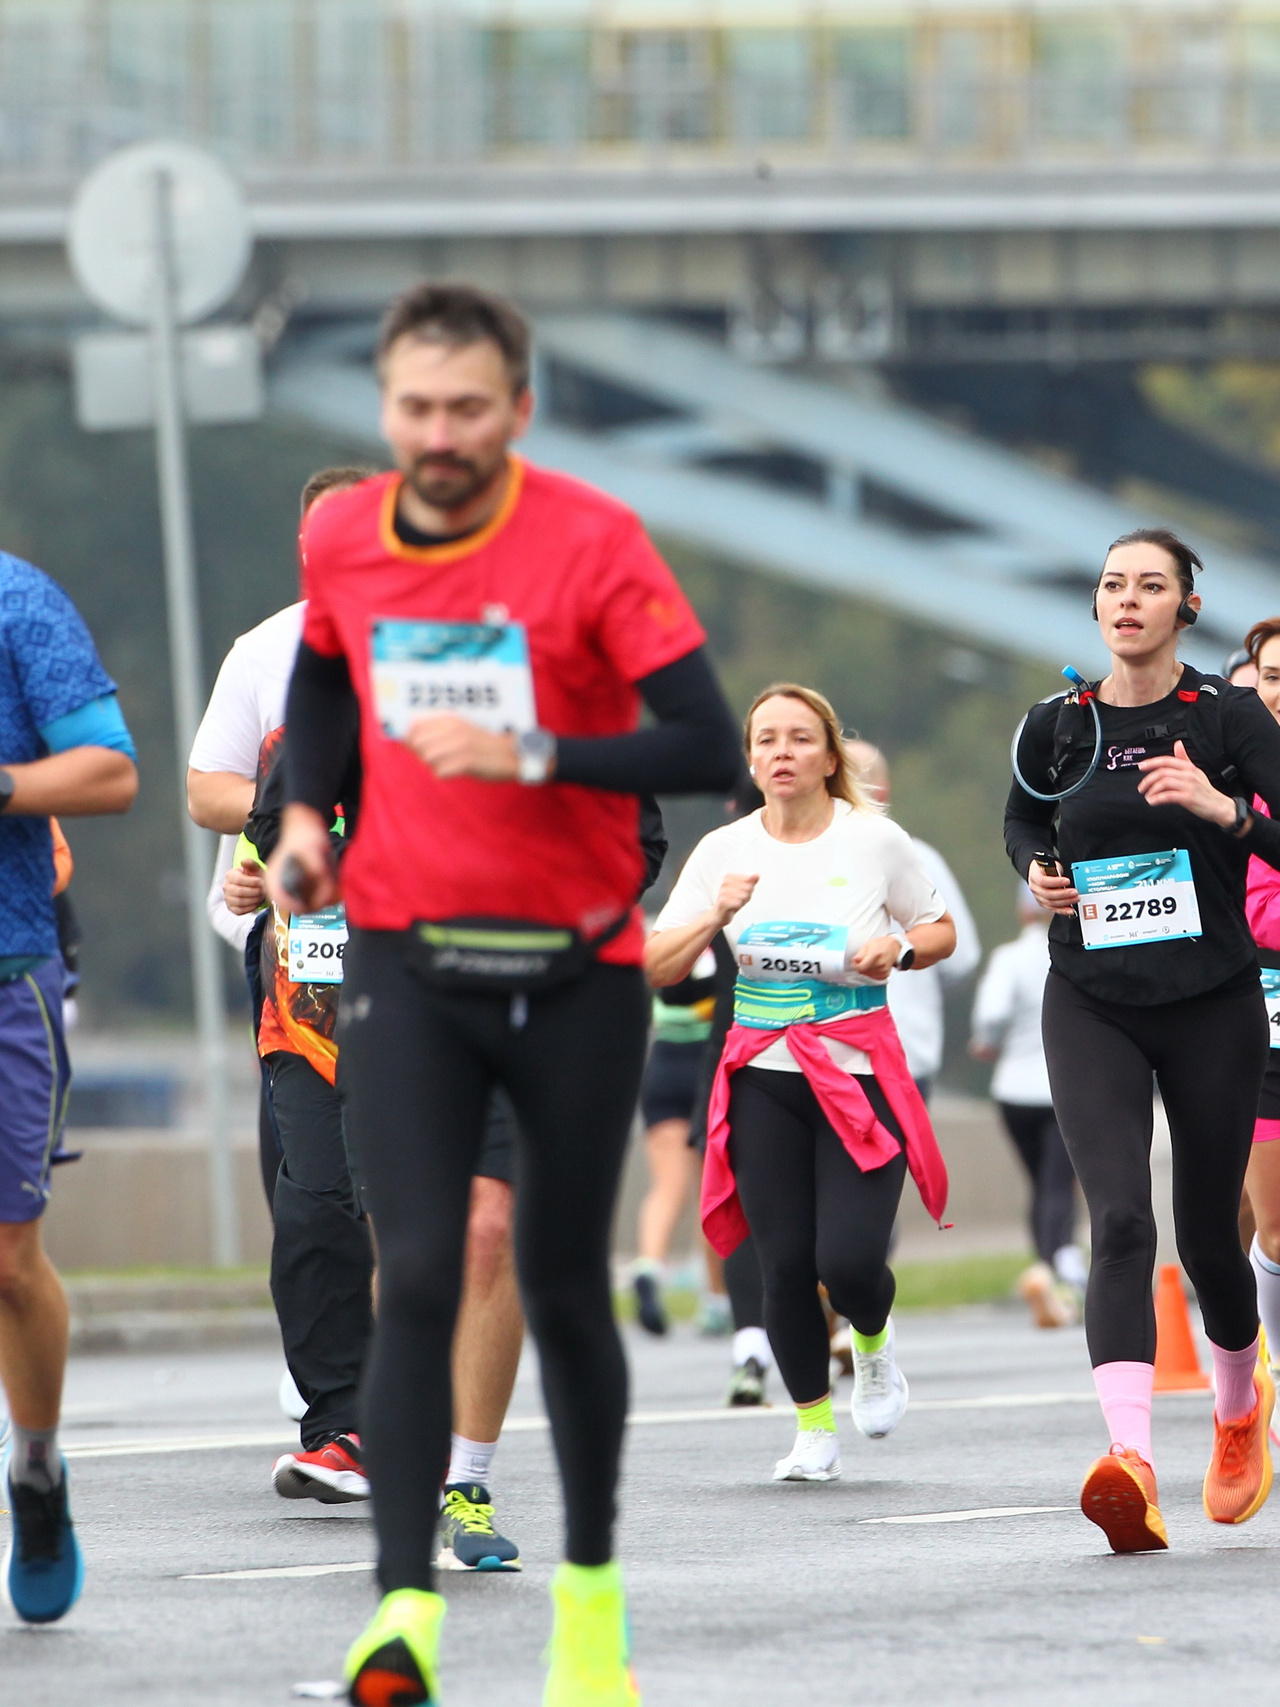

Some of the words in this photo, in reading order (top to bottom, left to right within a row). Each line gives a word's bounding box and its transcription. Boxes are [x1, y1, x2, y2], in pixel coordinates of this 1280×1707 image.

[1085, 905, 1095, 917] E
[1104, 896, 1178, 923] 22789
[761, 957, 822, 974] 20521
